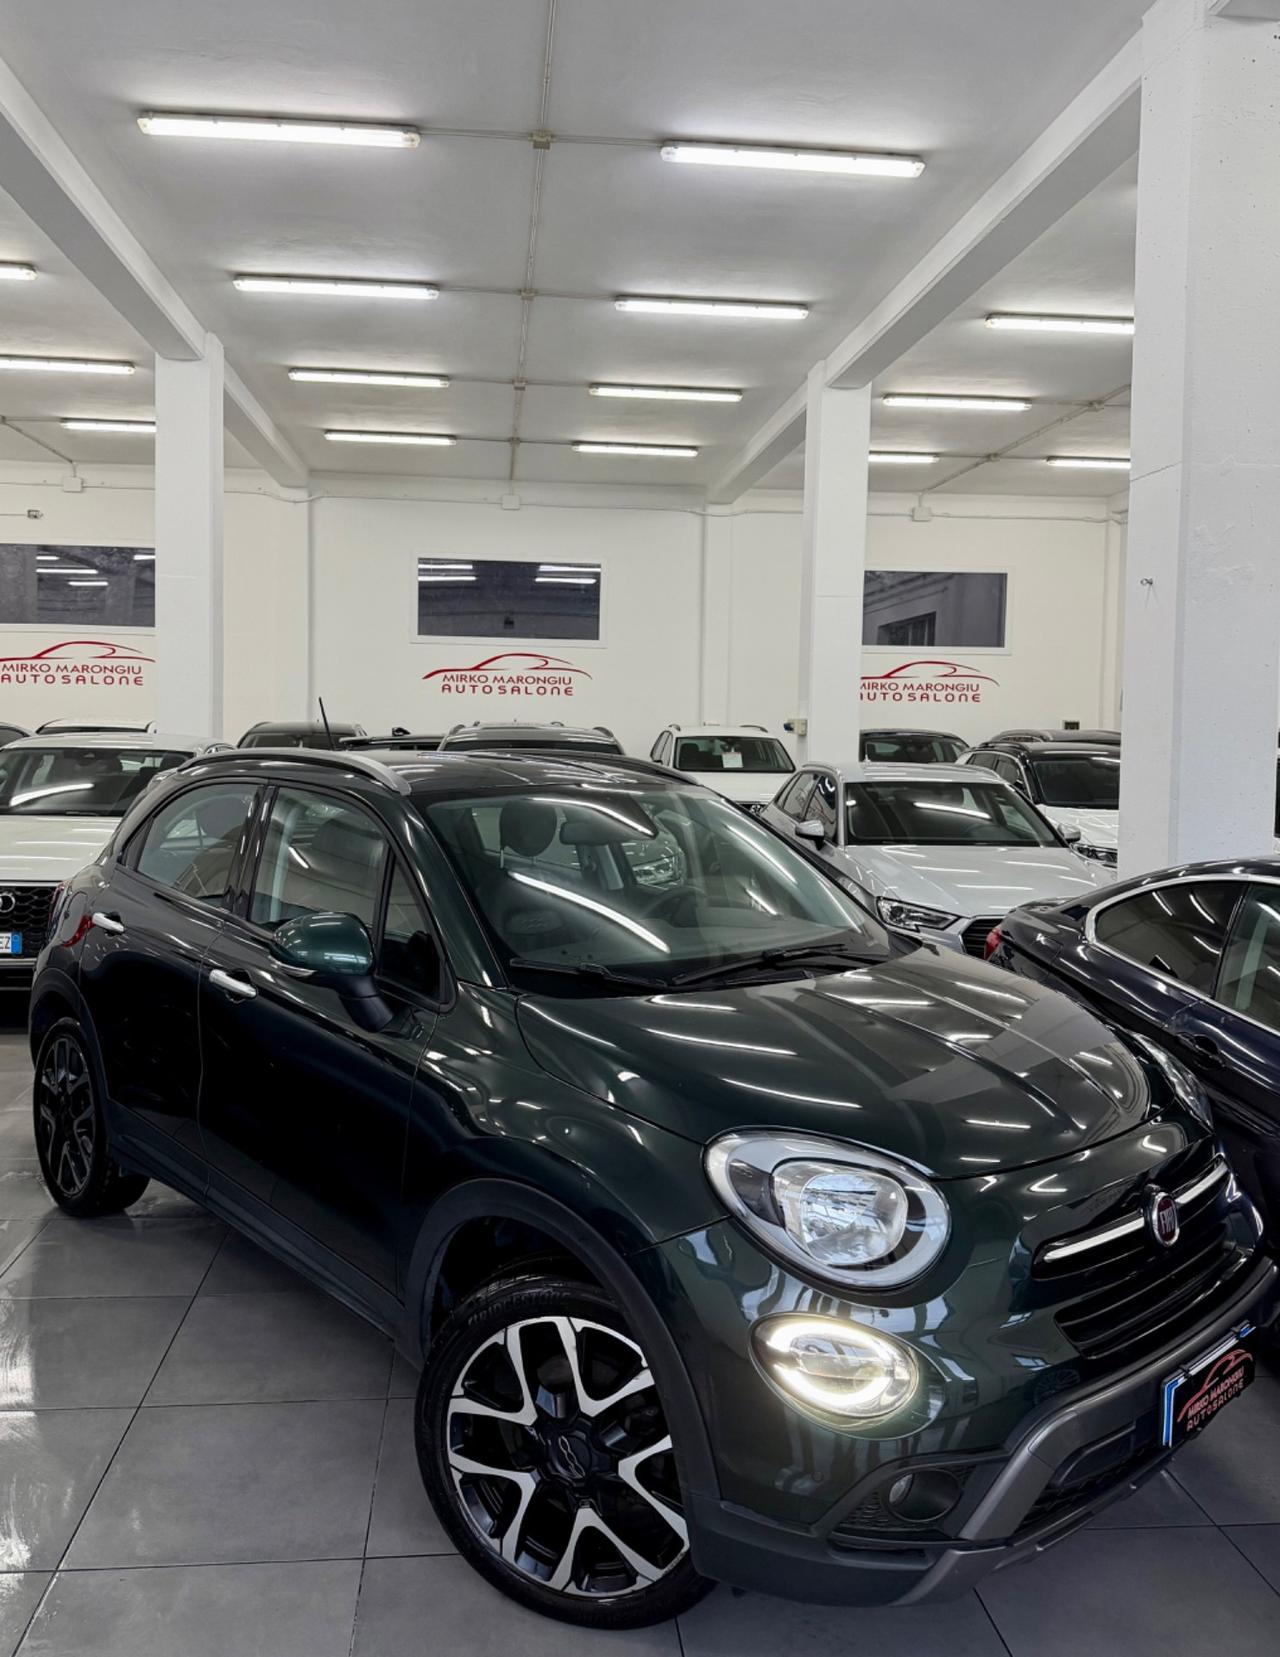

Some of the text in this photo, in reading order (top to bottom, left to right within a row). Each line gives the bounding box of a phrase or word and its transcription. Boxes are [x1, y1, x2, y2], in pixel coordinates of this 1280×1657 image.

[2, 663, 142, 674] MIRKO MARONGIU
[1, 673, 143, 685] AUTOSALONE
[442, 674, 572, 685] MIRKO MARONGIU
[442, 684, 574, 696] AUTOSALONE
[903, 683, 980, 692] MARONGIU
[860, 692, 981, 702] UTOSALONE
[1159, 1206, 1175, 1234] FIAT
